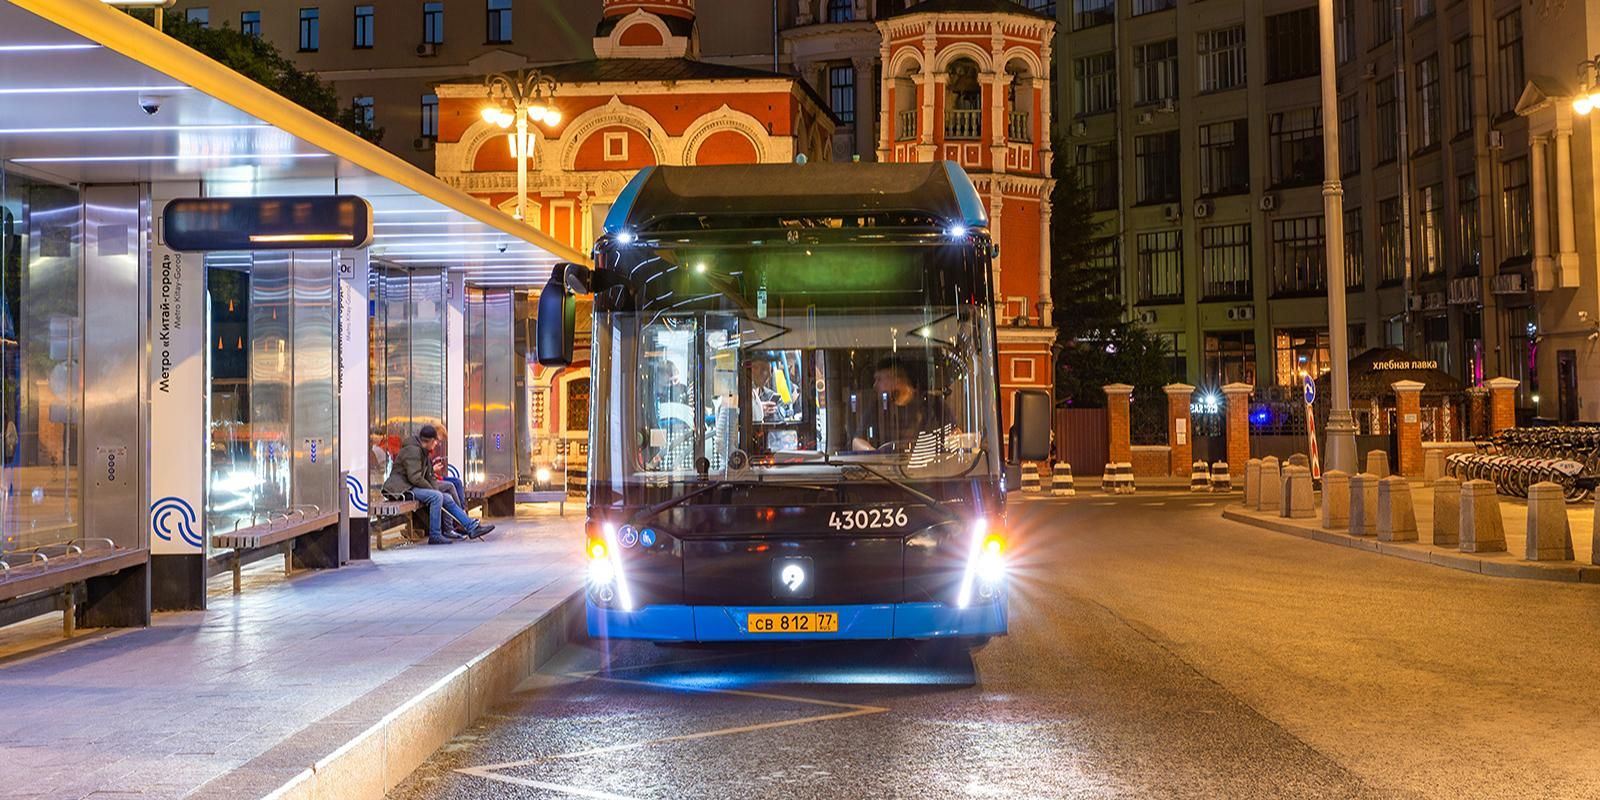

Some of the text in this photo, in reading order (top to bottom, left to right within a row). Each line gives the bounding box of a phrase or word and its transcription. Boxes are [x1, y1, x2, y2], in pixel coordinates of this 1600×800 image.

[173, 254, 182, 303] Kitay-Gorod
[159, 254, 171, 393] Метро «Китай-город»
[1373, 360, 1437, 370] хлебная лавка
[829, 507, 907, 530] 430236
[780, 615, 809, 630] 812
[817, 614, 833, 626] 77
